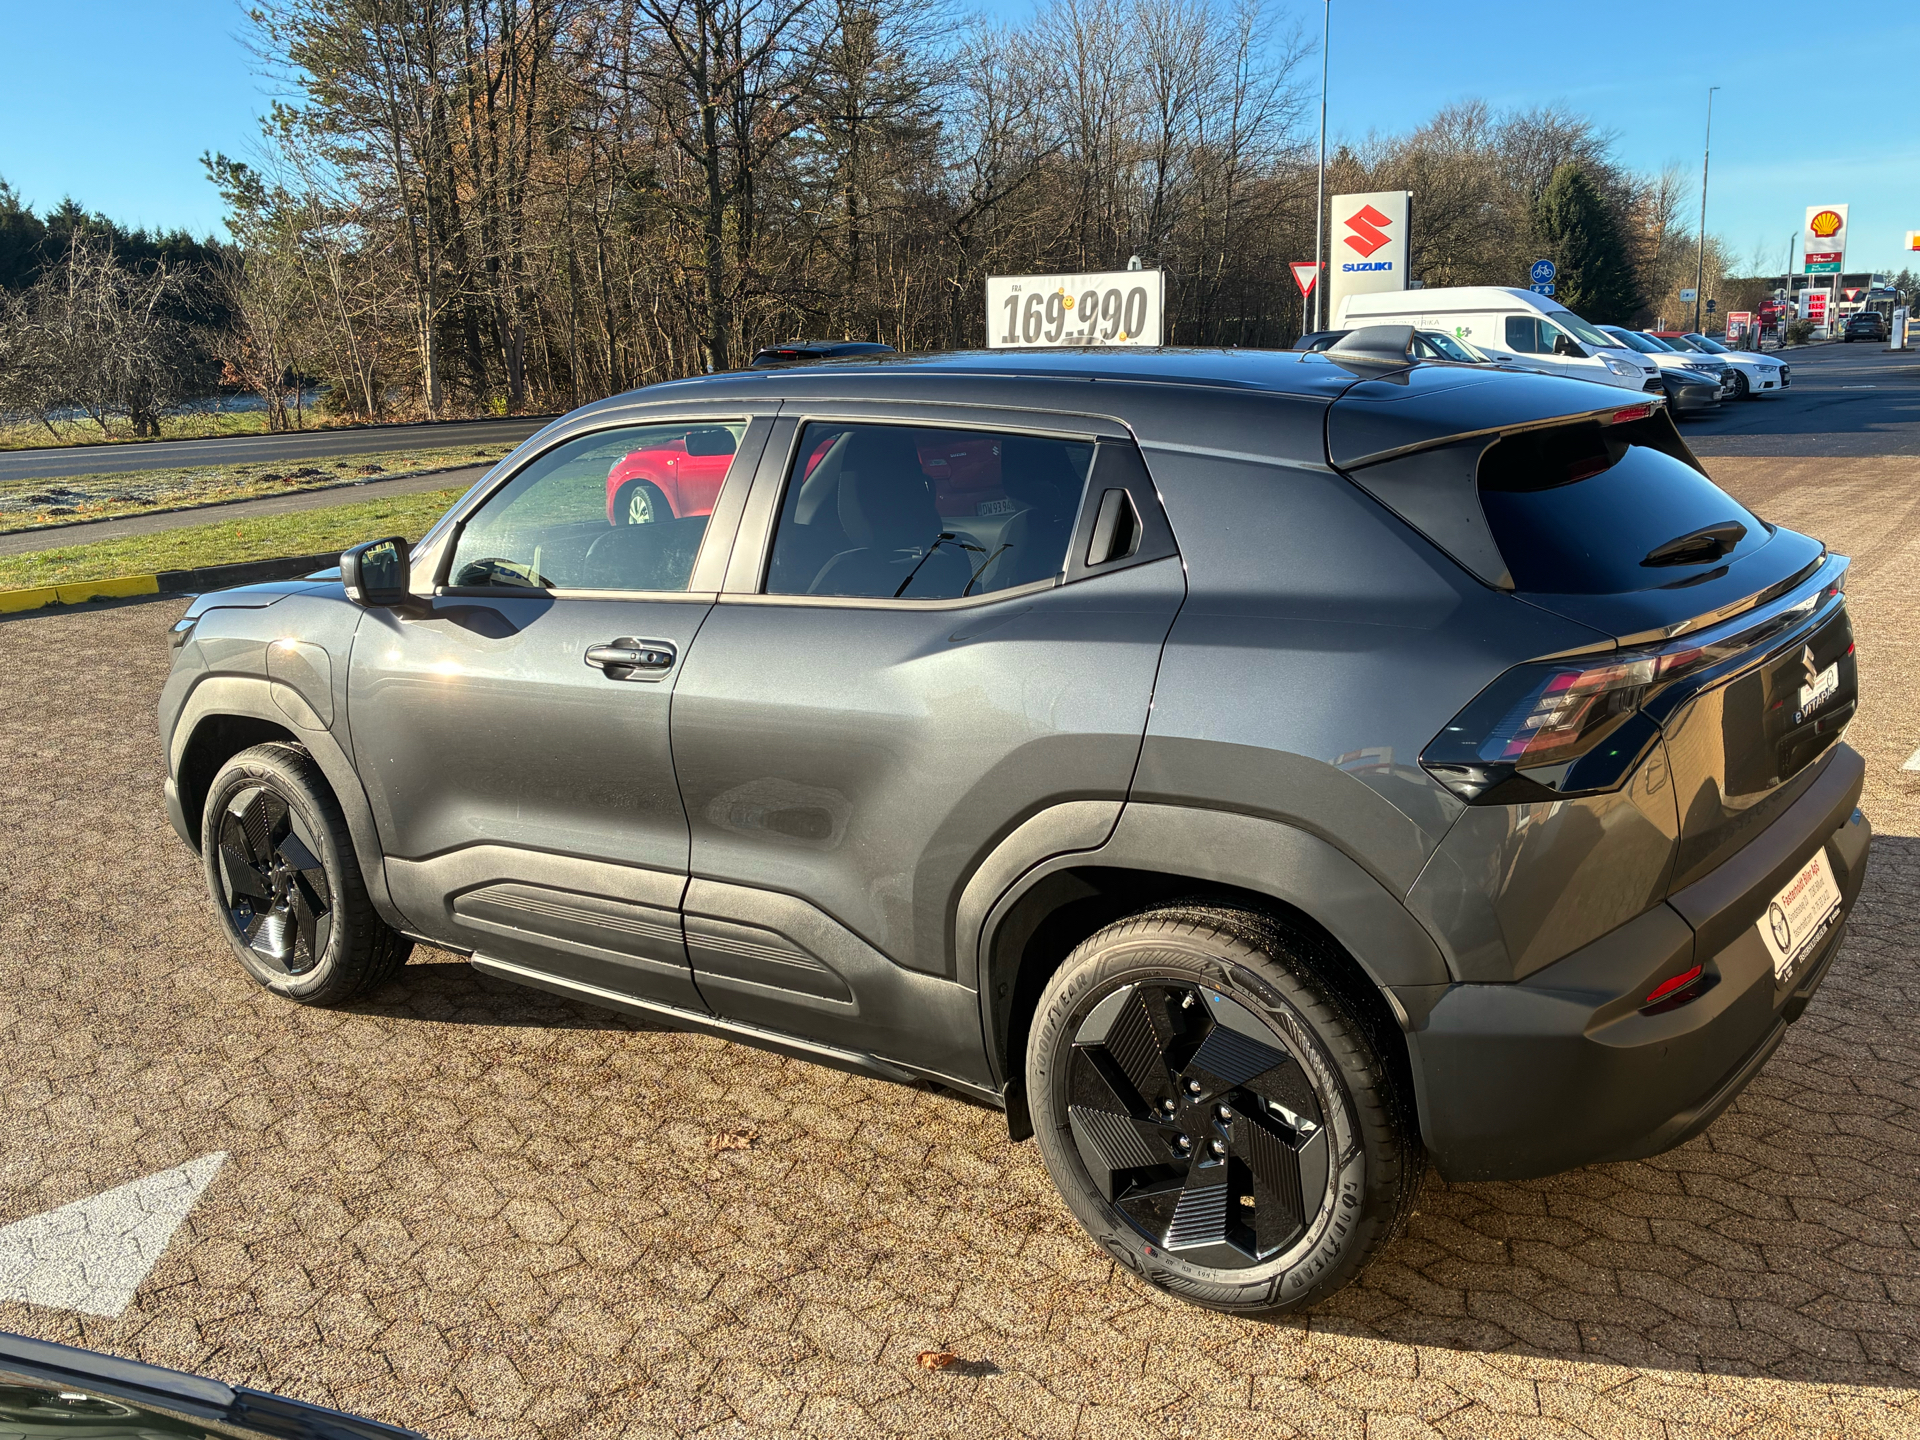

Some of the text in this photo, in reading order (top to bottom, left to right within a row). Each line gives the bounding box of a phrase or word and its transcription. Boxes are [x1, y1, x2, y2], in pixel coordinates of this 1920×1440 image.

[1011, 284, 1022, 292] FRA
[1342, 261, 1393, 272] SUZUKI
[1001, 286, 1148, 344] 169.990
[1035, 972, 1088, 1084] GOODYEAR
[1289, 1180, 1358, 1290] GOODYEAR
